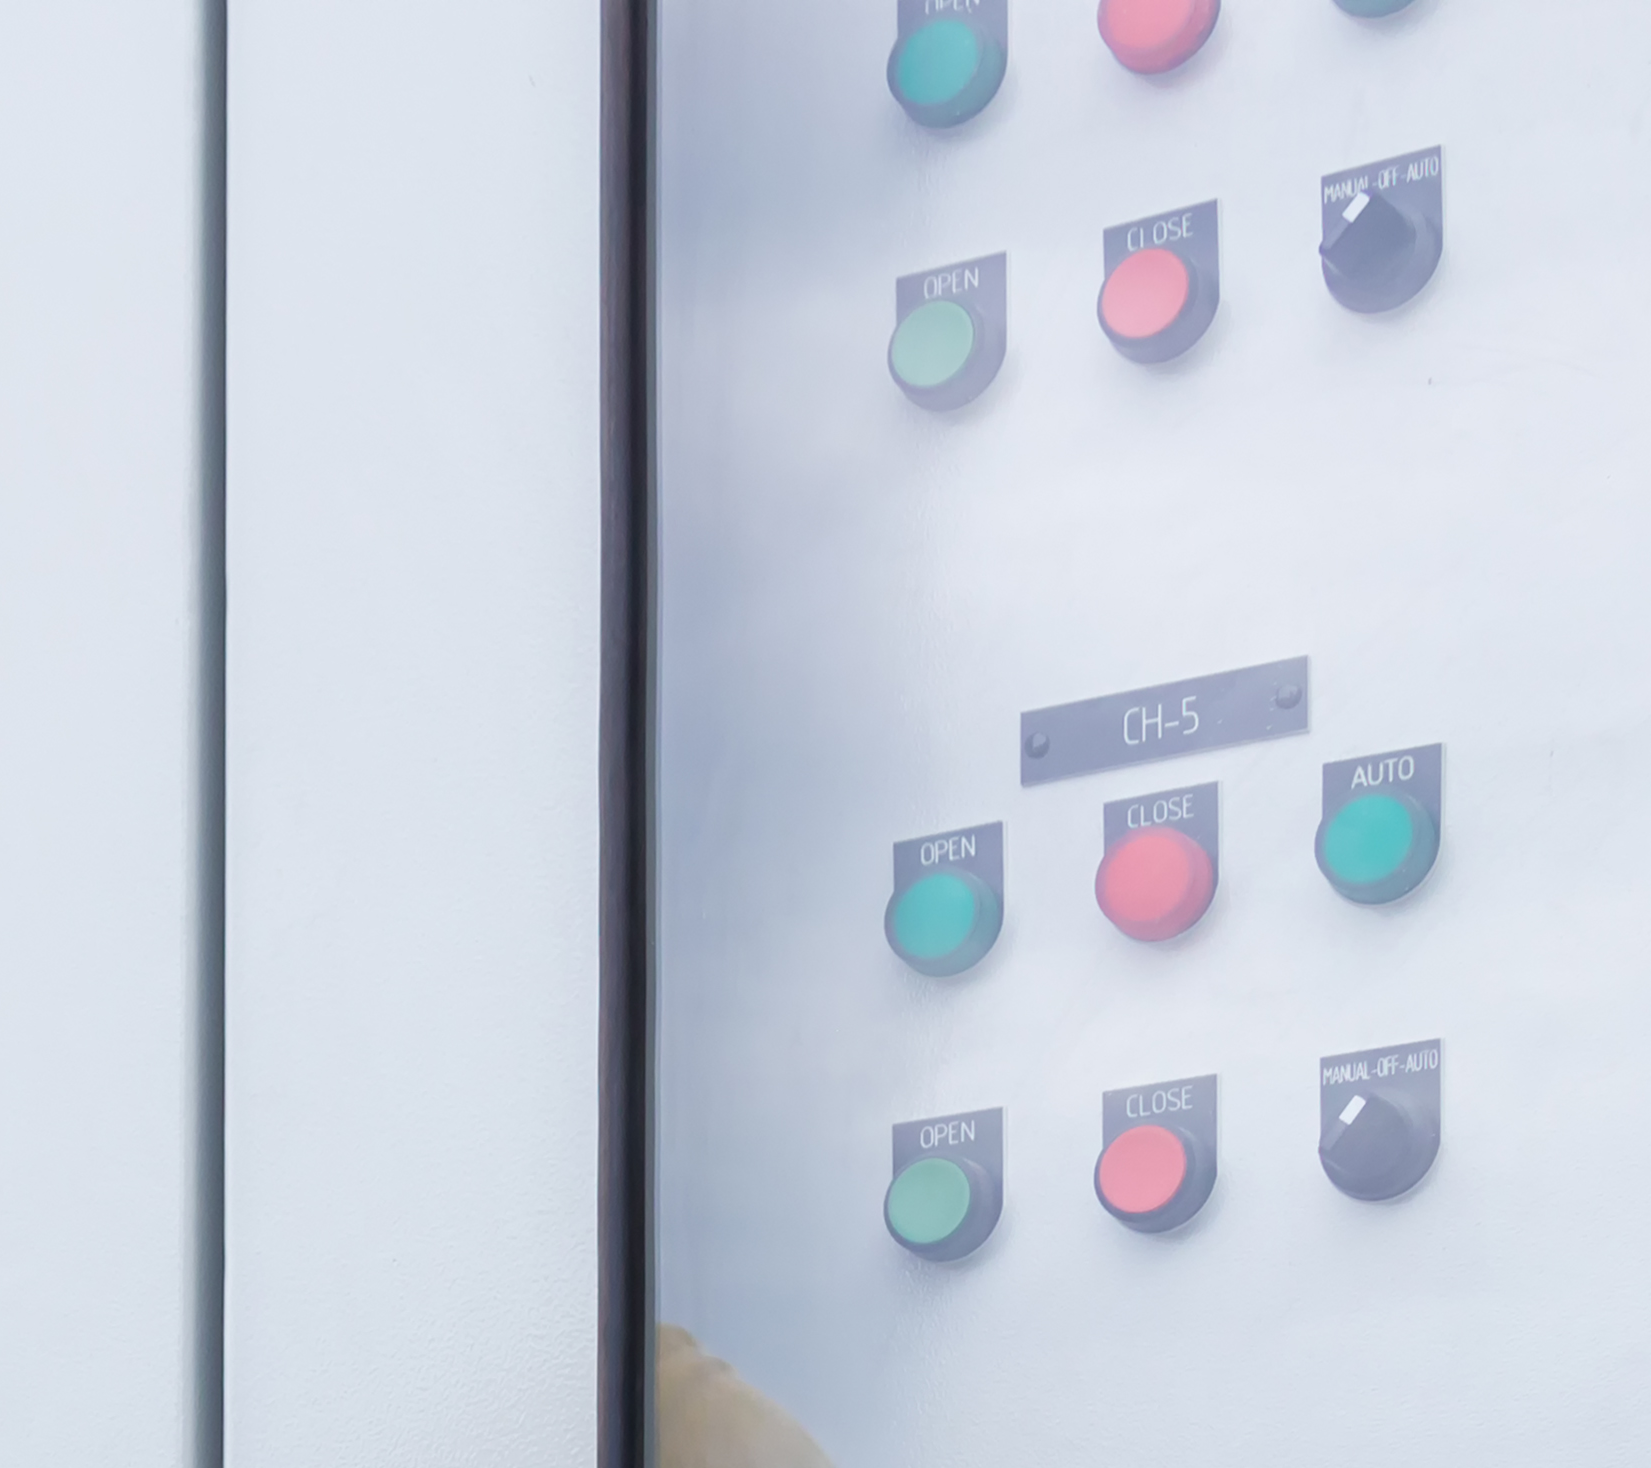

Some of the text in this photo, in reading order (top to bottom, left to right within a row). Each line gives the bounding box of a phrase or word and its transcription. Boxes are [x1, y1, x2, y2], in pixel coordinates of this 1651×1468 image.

[1126, 212, 1193, 252] CLOSE
[923, 266, 979, 300] OPEN
[1123, 695, 1200, 745] CH-5
[1350, 755, 1415, 790] AUTO
[1127, 793, 1194, 829] CLOSE
[920, 834, 976, 866] OPEN
[1322, 1048, 1439, 1086] MANUAL-OFF-AUTO
[1126, 1085, 1193, 1118] CLOSE
[919, 1119, 976, 1149] OPEN
